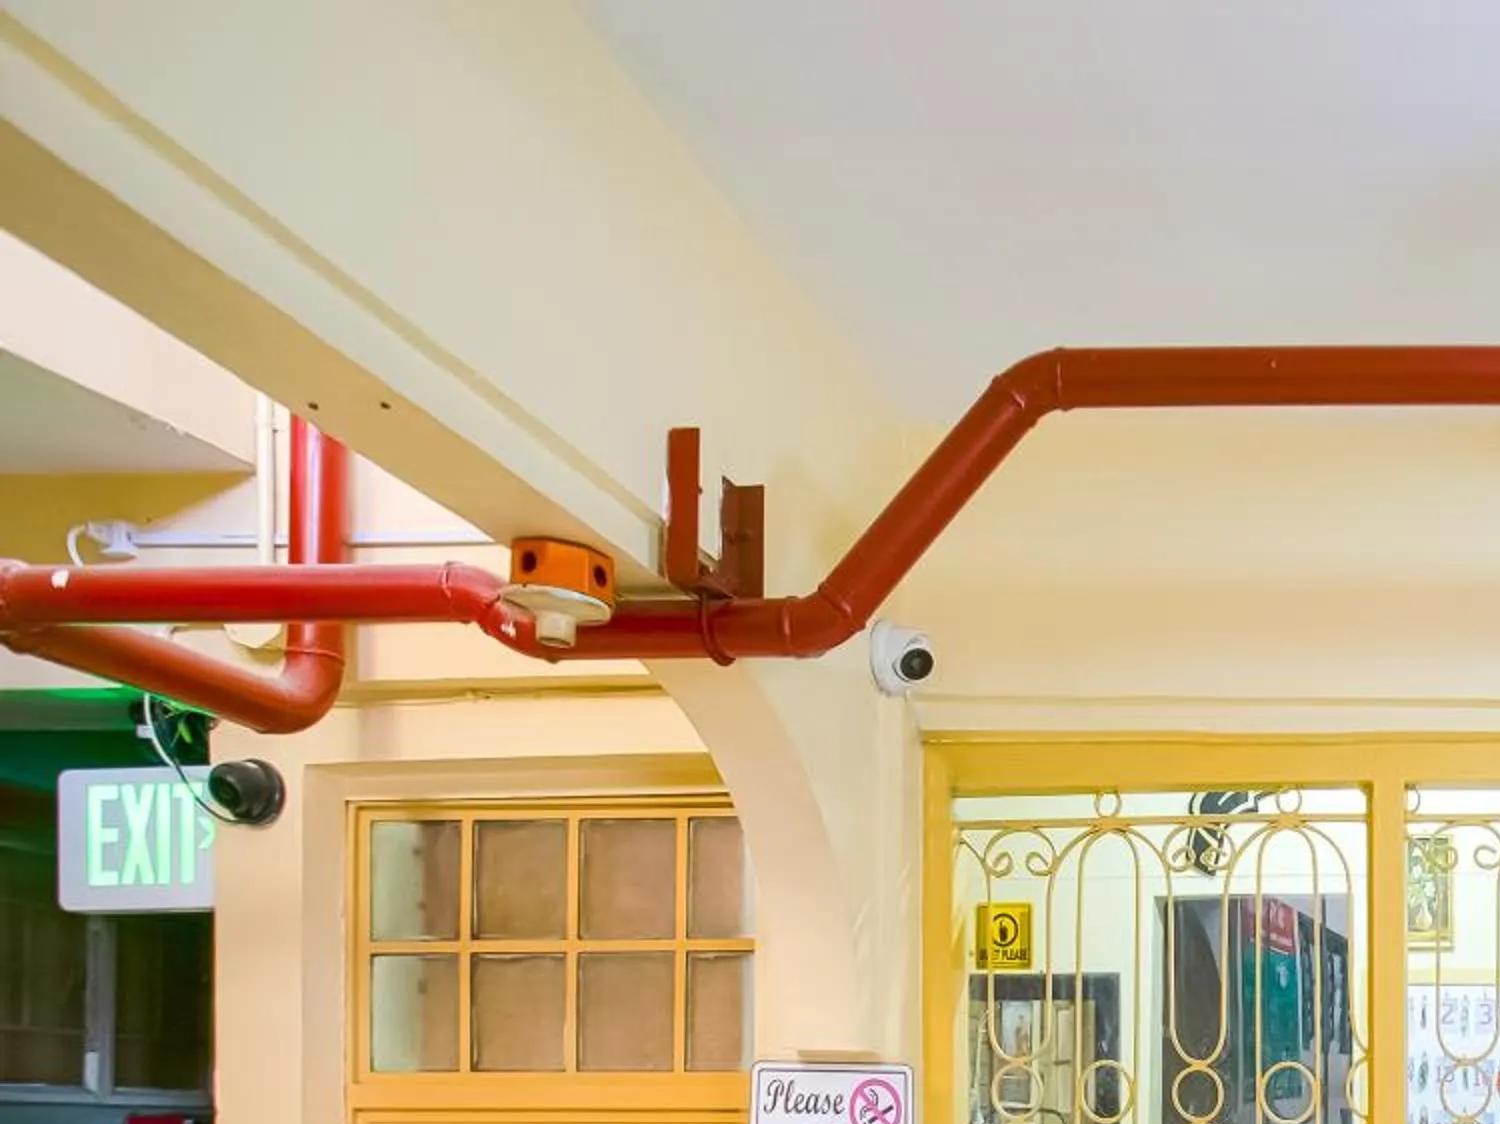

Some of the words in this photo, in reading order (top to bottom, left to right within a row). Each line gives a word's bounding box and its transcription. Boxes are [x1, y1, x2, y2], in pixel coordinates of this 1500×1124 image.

[87, 782, 205, 886] EXIT
[1441, 1002, 1454, 1025] 2
[1479, 1002, 1492, 1025] 3
[764, 1078, 846, 1115] Please
